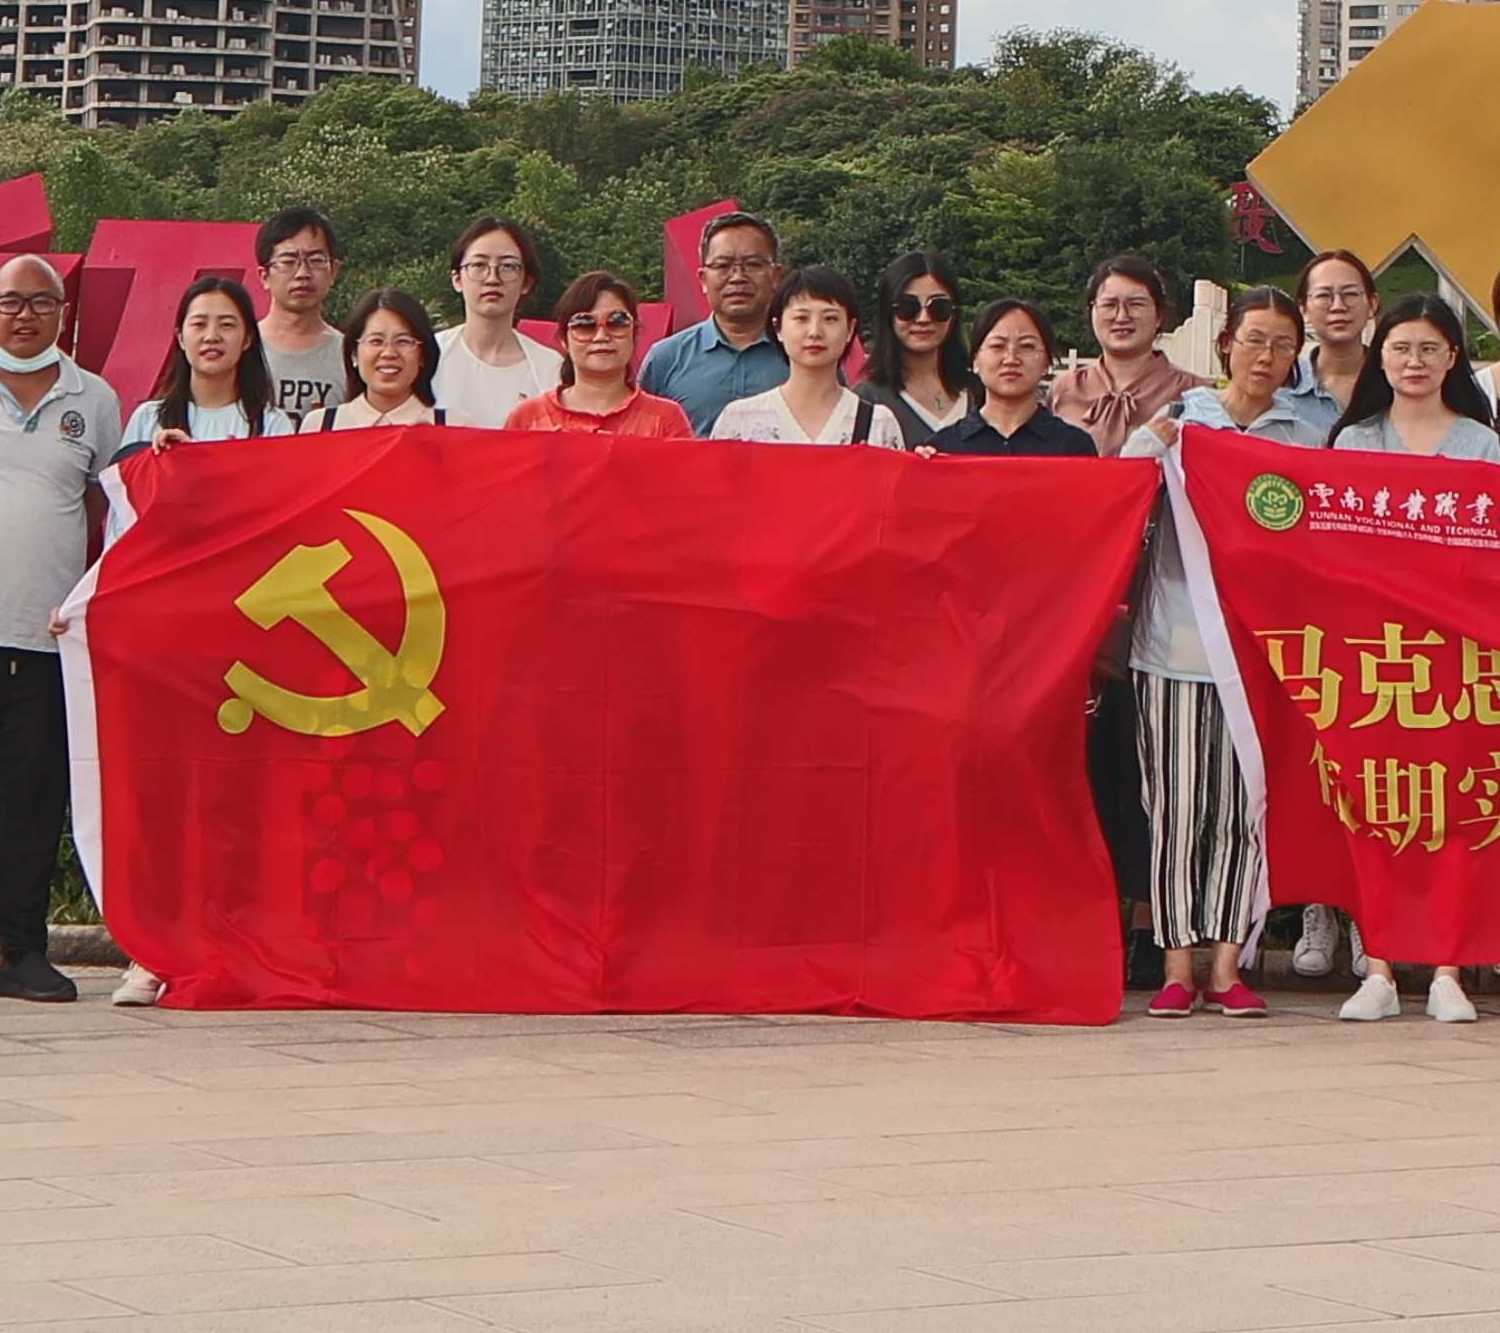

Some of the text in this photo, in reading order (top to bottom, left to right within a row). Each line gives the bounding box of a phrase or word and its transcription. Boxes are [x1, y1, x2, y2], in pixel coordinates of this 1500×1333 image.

[1309, 511, 1352, 522] YUNNAN
[1355, 515, 1416, 531] VOCATIONAL
[1420, 524, 1441, 534] AND
[1445, 525, 1498, 539] TECHNICAL
